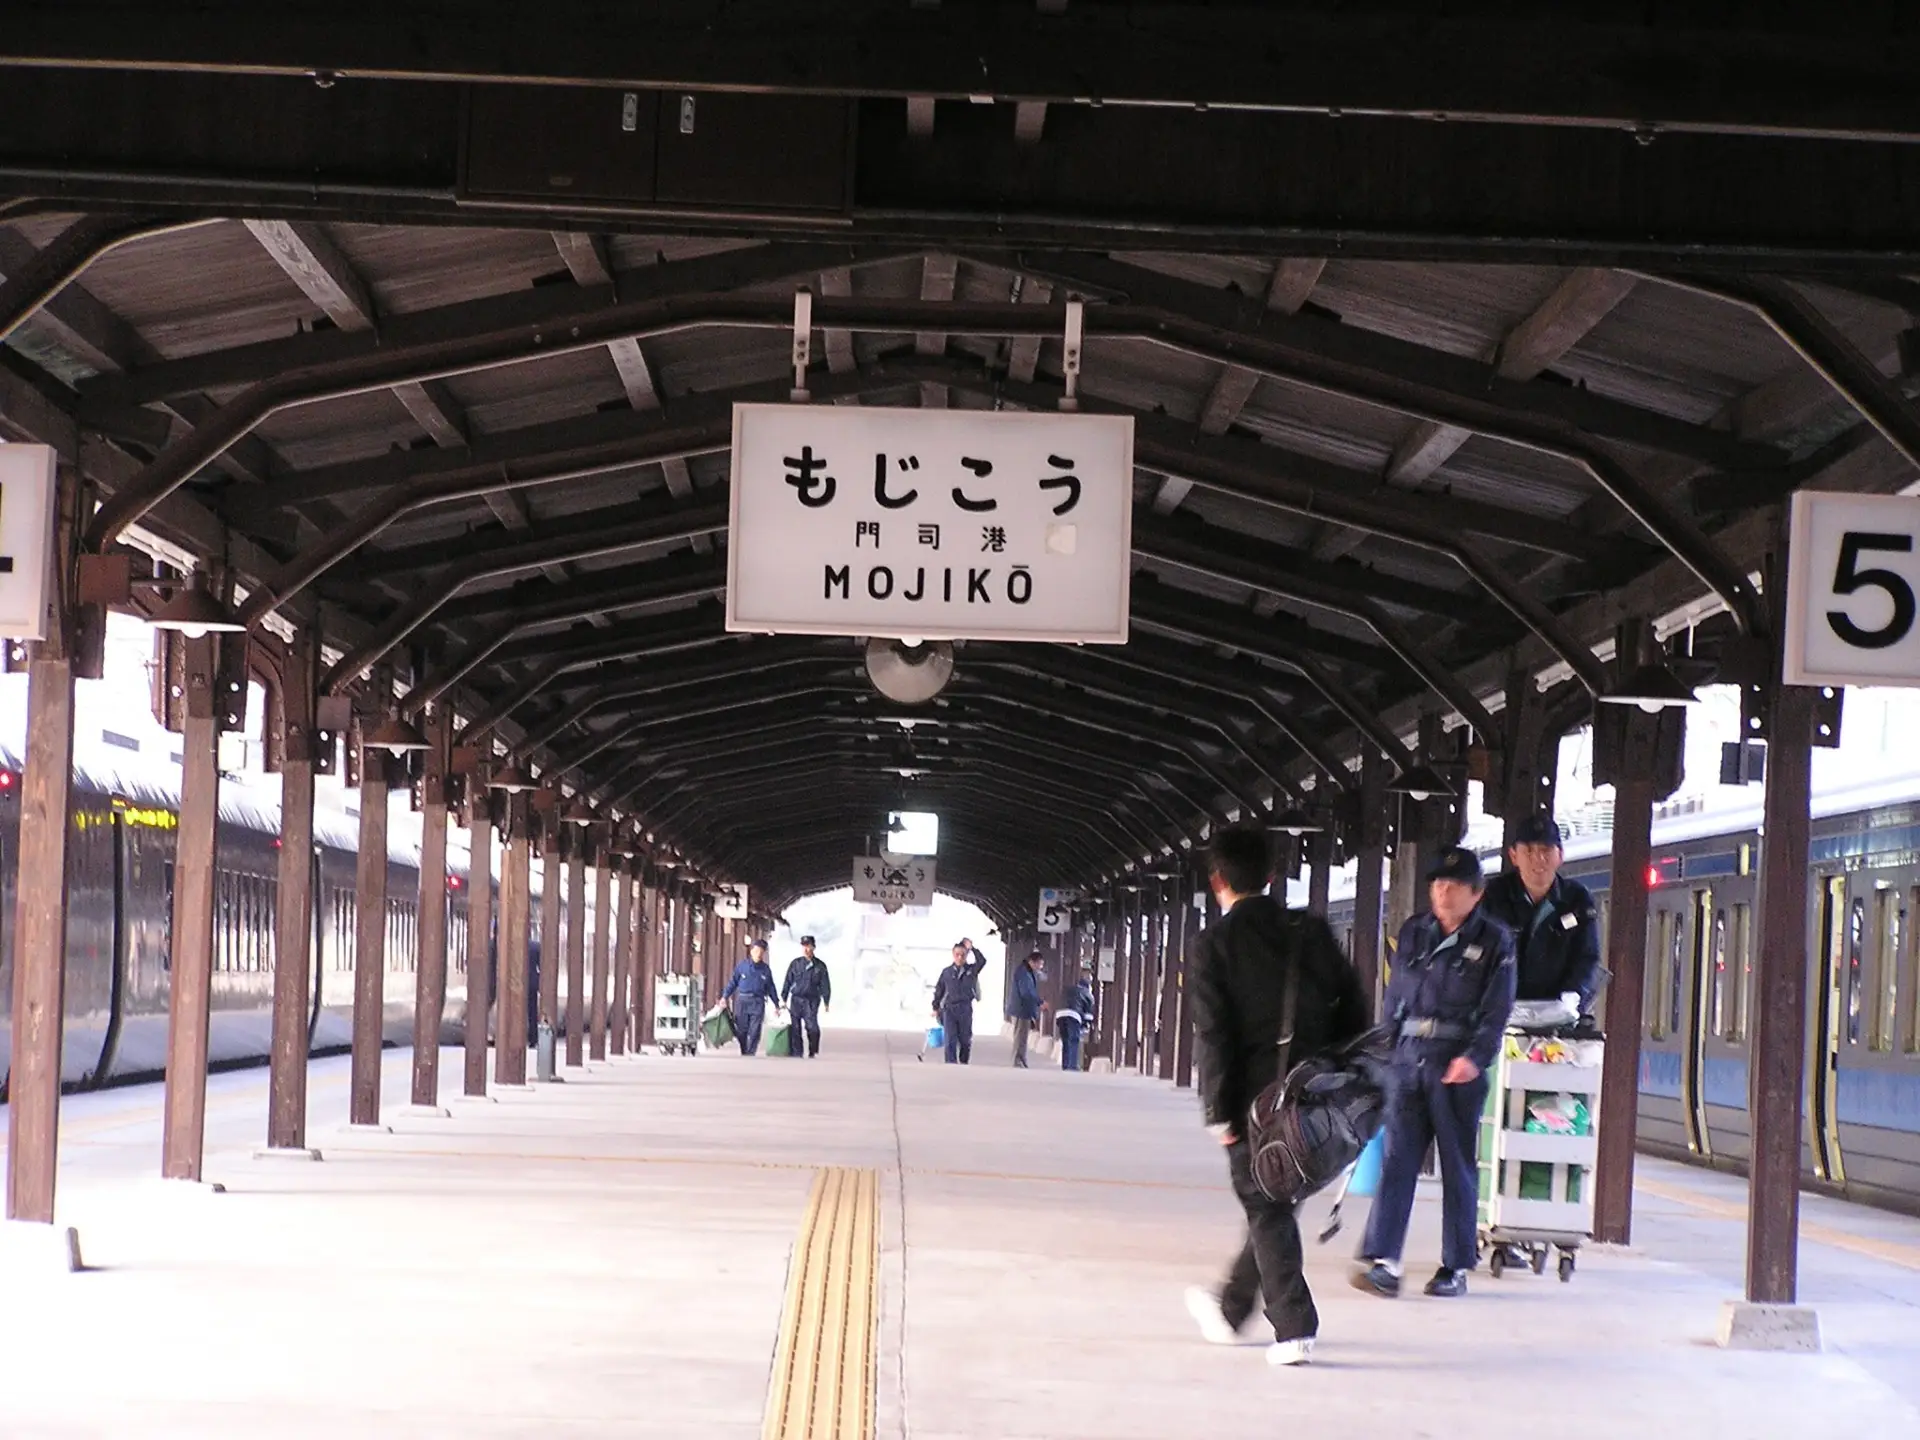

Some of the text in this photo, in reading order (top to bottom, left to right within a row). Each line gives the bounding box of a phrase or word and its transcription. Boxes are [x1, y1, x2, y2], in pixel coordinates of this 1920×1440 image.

[783, 446, 1082, 516] もじこう
[855, 521, 1007, 553] 門司港
[1826, 531, 1916, 649] 5
[1043, 906, 1061, 926] 5
